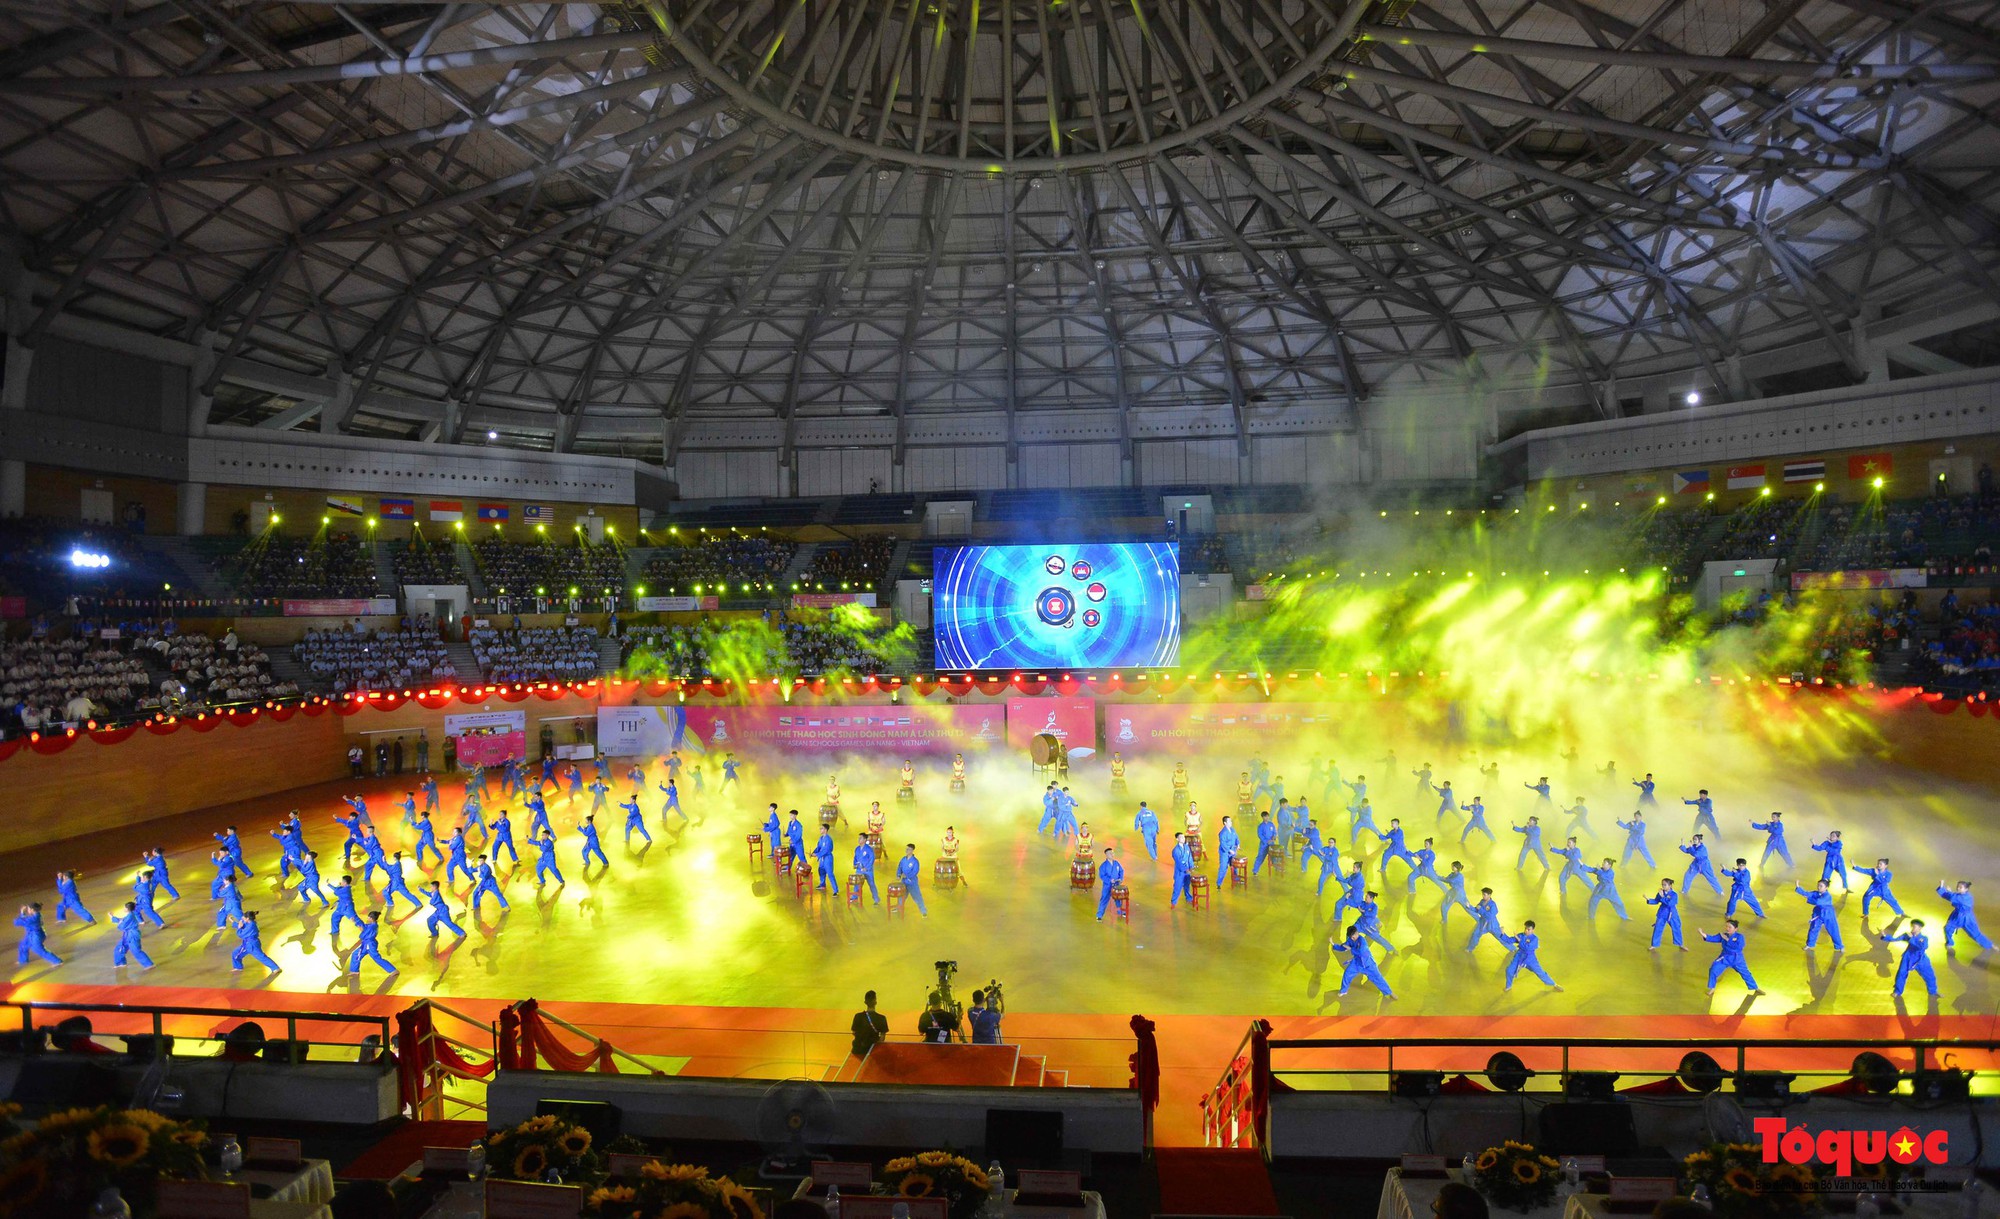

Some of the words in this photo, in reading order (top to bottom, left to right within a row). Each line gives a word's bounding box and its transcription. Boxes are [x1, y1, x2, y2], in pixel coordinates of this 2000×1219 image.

[617, 720, 638, 732] TH
[792, 730, 816, 738] THAO
[838, 730, 858, 738] SINH
[887, 730, 908, 738] NAM
